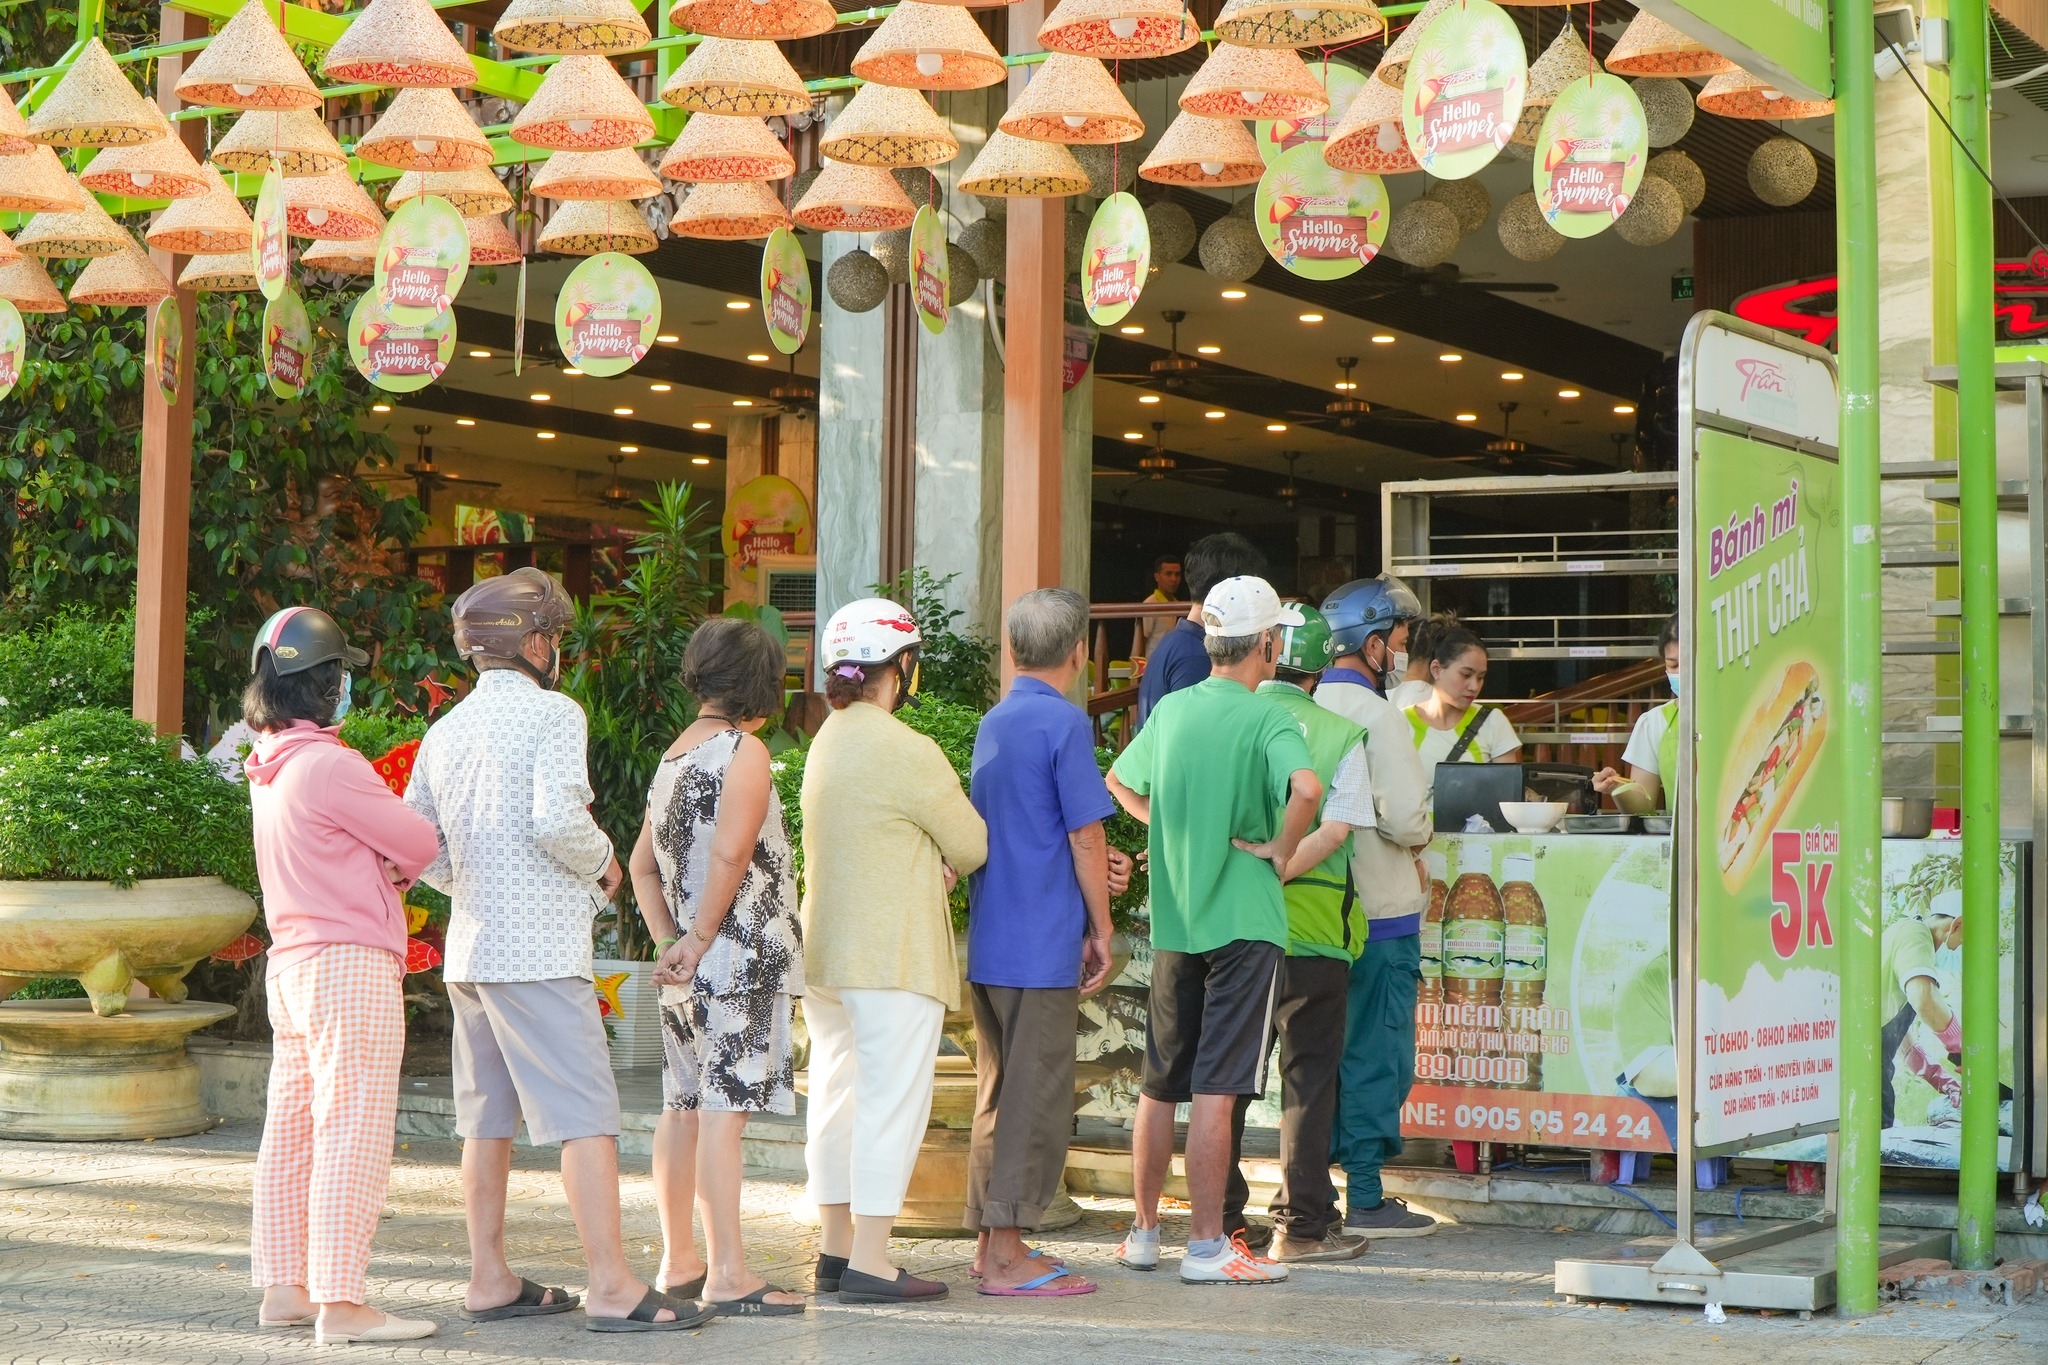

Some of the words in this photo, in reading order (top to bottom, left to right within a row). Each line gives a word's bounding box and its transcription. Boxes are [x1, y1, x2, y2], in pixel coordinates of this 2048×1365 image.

[1442, 100, 1480, 122] Hello
[1427, 112, 1497, 152] Summer
[1569, 167, 1604, 184] Hello
[1551, 177, 1616, 209] Summer
[1302, 220, 1343, 234] Hello
[1285, 228, 1363, 254] Summer
[402, 270, 430, 285] Hello
[923, 275, 937, 294] Hello
[1103, 267, 1124, 282] Hello
[388, 277, 439, 304] Summer
[1092, 278, 1131, 304] Summer
[771, 299, 799, 335] Summer
[779, 294, 795, 315] Hello
[574, 331, 634, 354] Summer
[590, 324, 622, 336] Hello
[279, 347, 295, 364] Hello
[370, 350, 433, 371] Summer
[386, 343, 419, 355] Hello
[753, 536, 780, 549] Hello
[1710, 510, 1765, 580] Bánh
[1711, 573, 1761, 670] THỊT
[1767, 525, 1810, 635] CHẢ
[495, 618, 515, 626] Asia
[1805, 823, 1821, 853] GIÁ
[1823, 822, 1838, 853] CHỈ
[1770, 831, 1833, 960] 5K
[1444, 1001, 1501, 1028] NÊM
[1507, 1000, 1569, 1031] TRẦN
[1442, 1027, 1458, 1049] TỪ
[1460, 1028, 1476, 1049] CÁ
[1479, 1032, 1504, 1051] THU
[1506, 1029, 1540, 1053] TRÊN
[1540, 1034, 1549, 1053] 5
[1551, 1035, 1569, 1054] KG
[1704, 1027, 1718, 1055] TỪ
[1720, 1030, 1749, 1053] 06H00
[1757, 1025, 1785, 1048] 08H00
[1787, 1017, 1810, 1043] HÀNG
[1812, 1014, 1836, 1041] NGÀY
[1724, 1066, 1743, 1088] HÀNG
[1744, 1063, 1762, 1084] TRẦN
[1767, 1066, 1774, 1080] 11
[1775, 1059, 1801, 1079] NGUYỄN
[1802, 1057, 1816, 1075] VĂN
[1817, 1057, 1833, 1073] LINH
[1738, 1092, 1756, 1113] HÀNG
[1758, 1088, 1776, 1109] TRẦN
[1781, 1089, 1790, 1105] 04
[1791, 1085, 1800, 1103] LÊ
[1400, 1101, 1445, 1126] INE:
[1454, 1104, 1521, 1131] 0905
[1529, 1109, 1563, 1134] 95
[1573, 1112, 1607, 1136] 24
[1616, 1114, 1651, 1139] 24
